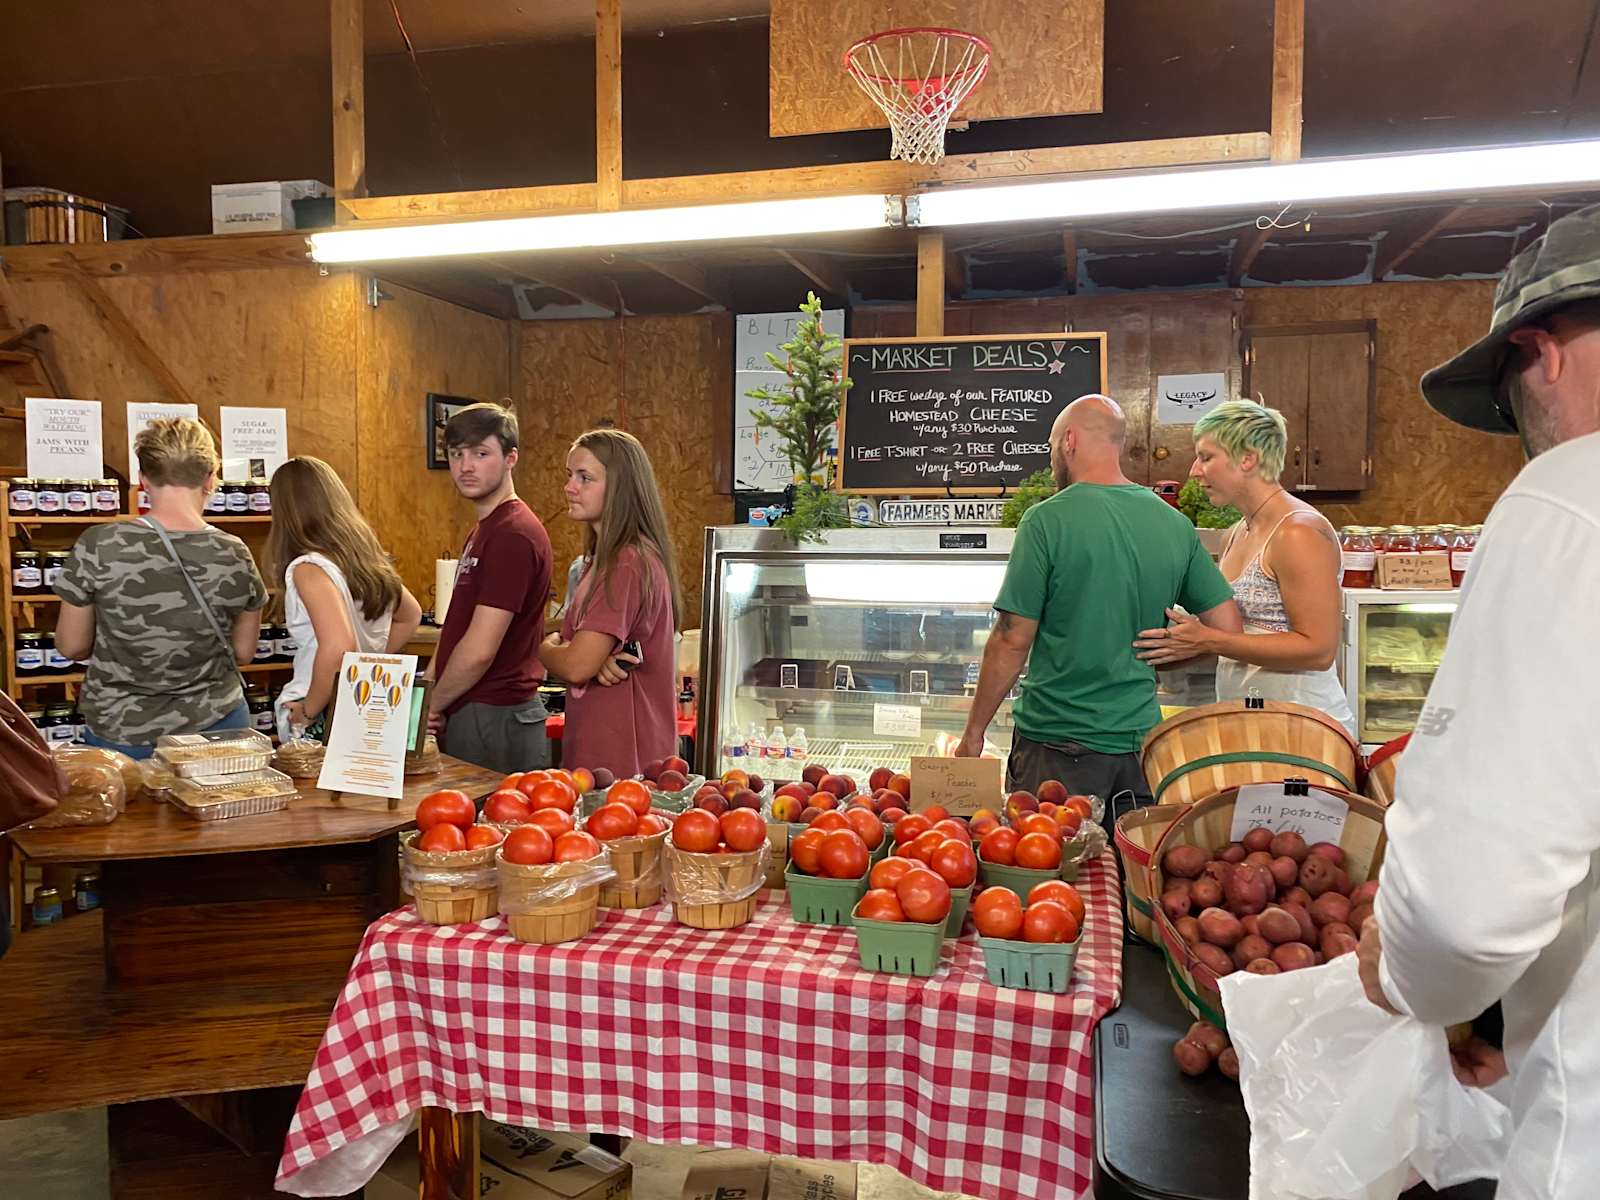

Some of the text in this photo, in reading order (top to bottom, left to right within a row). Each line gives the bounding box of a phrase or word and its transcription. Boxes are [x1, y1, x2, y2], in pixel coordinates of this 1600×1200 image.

[871, 346, 958, 370] MARKET
[878, 389, 909, 404] FREE
[909, 388, 948, 409] wedge
[949, 388, 965, 407] of
[965, 390, 988, 401] our
[991, 388, 1053, 404] FEATURED
[1173, 391, 1207, 399] LEGACY
[889, 406, 1038, 423] HOMESTEAD CHEESE
[232, 427, 277, 436] FREE JAMS
[241, 420, 268, 428] SUGAR
[912, 421, 1018, 439] w/any $30 Purchase
[36, 438, 61, 446] JAMS
[49, 446, 86, 456] PECANS
[857, 446, 881, 460] FREE
[883, 445, 929, 458] T-SHIRT
[952, 442, 964, 456] 2
[966, 442, 996, 455] FREE
[1002, 440, 1051, 455] CHEESES
[915, 461, 953, 481] w/any
[954, 461, 978, 474] $50
[887, 503, 1003, 521] FARMERS MARKE
[1250, 804, 1343, 826] All potatoes
